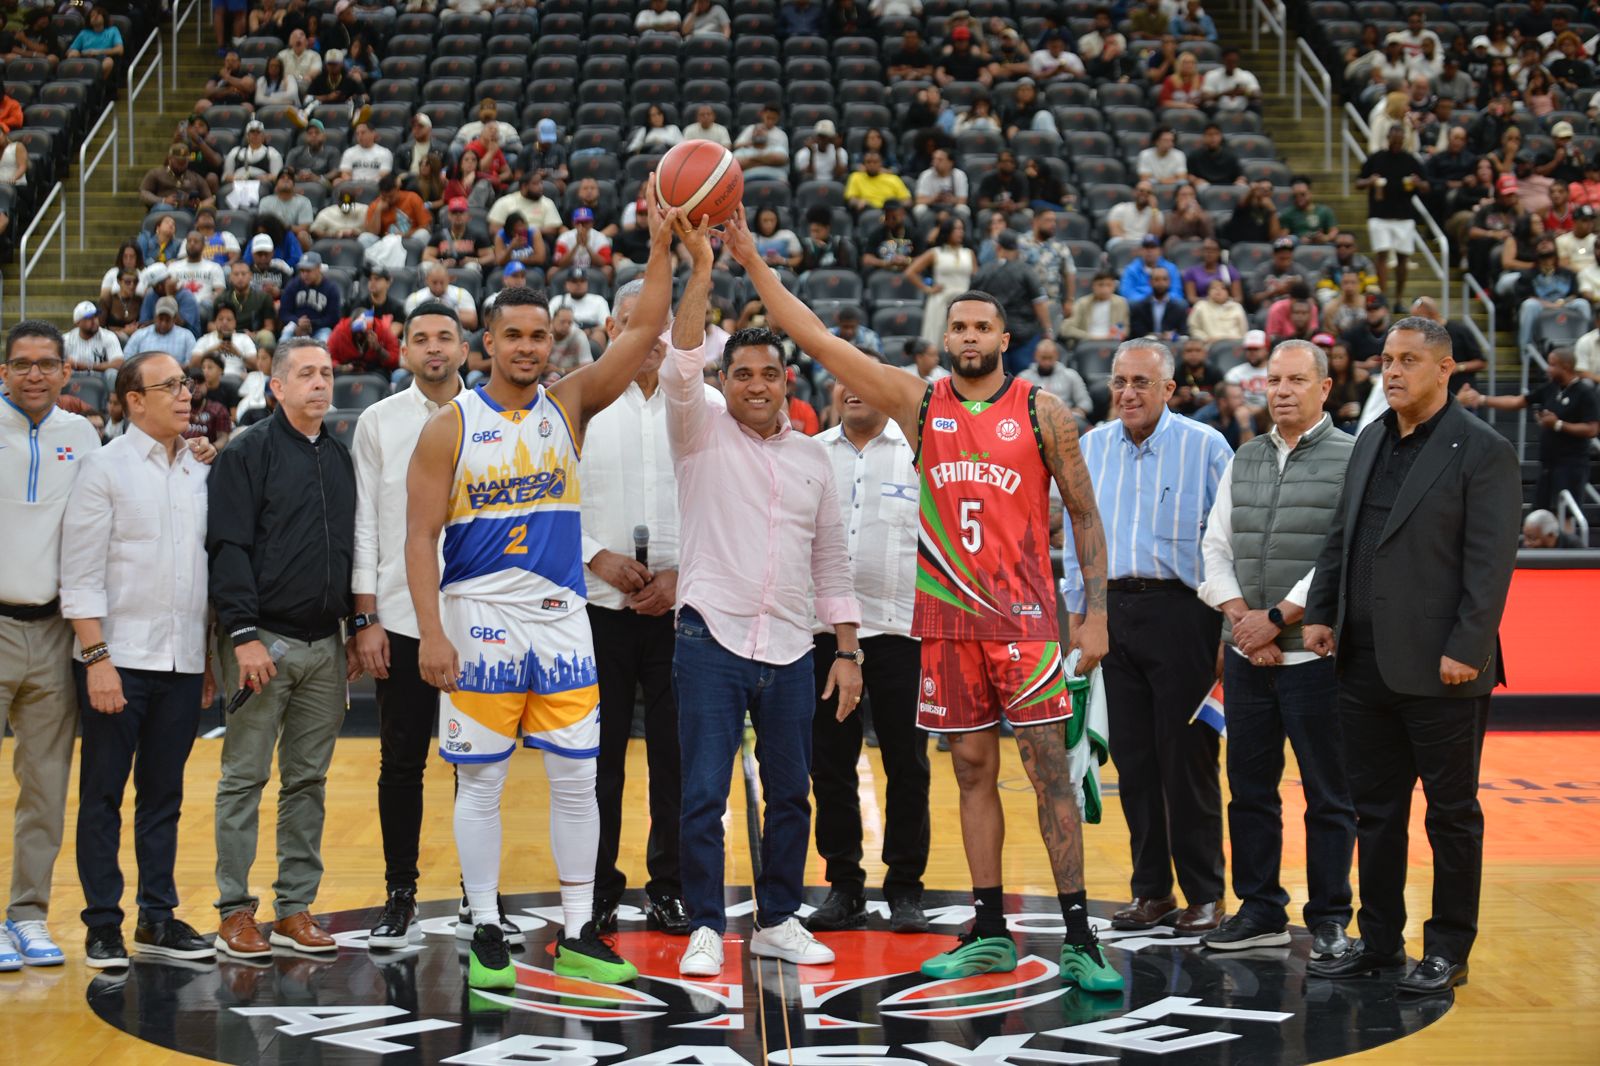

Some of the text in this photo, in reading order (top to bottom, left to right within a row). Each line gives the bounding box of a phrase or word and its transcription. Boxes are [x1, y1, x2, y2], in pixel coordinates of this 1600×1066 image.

[472, 429, 502, 443] GBC
[935, 420, 956, 430] GBC
[469, 481, 549, 510] BAEZ
[958, 497, 984, 555] 5
[503, 523, 529, 554] 2
[470, 626, 506, 641] GBC
[1007, 642, 1021, 662] 5
[228, 1004, 461, 1054] AL
